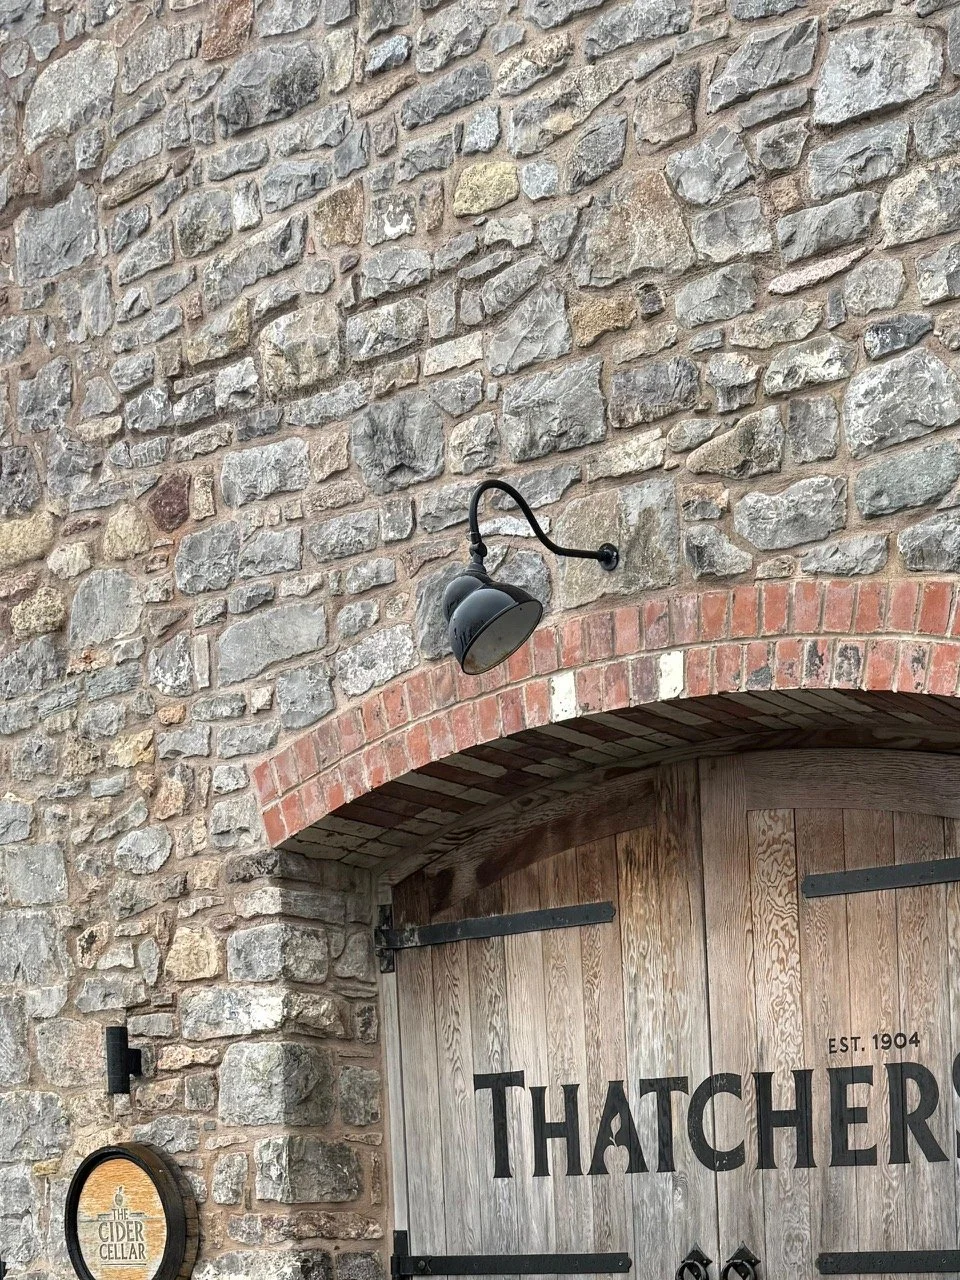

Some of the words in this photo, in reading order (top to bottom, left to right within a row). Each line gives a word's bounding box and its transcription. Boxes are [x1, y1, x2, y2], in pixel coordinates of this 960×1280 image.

[828, 1036, 866, 1054] EST.
[872, 1031, 921, 1050] 1904
[112, 1208, 129, 1220] THE
[98, 1221, 145, 1242] CIDER
[99, 1243, 146, 1260] CELLAR
